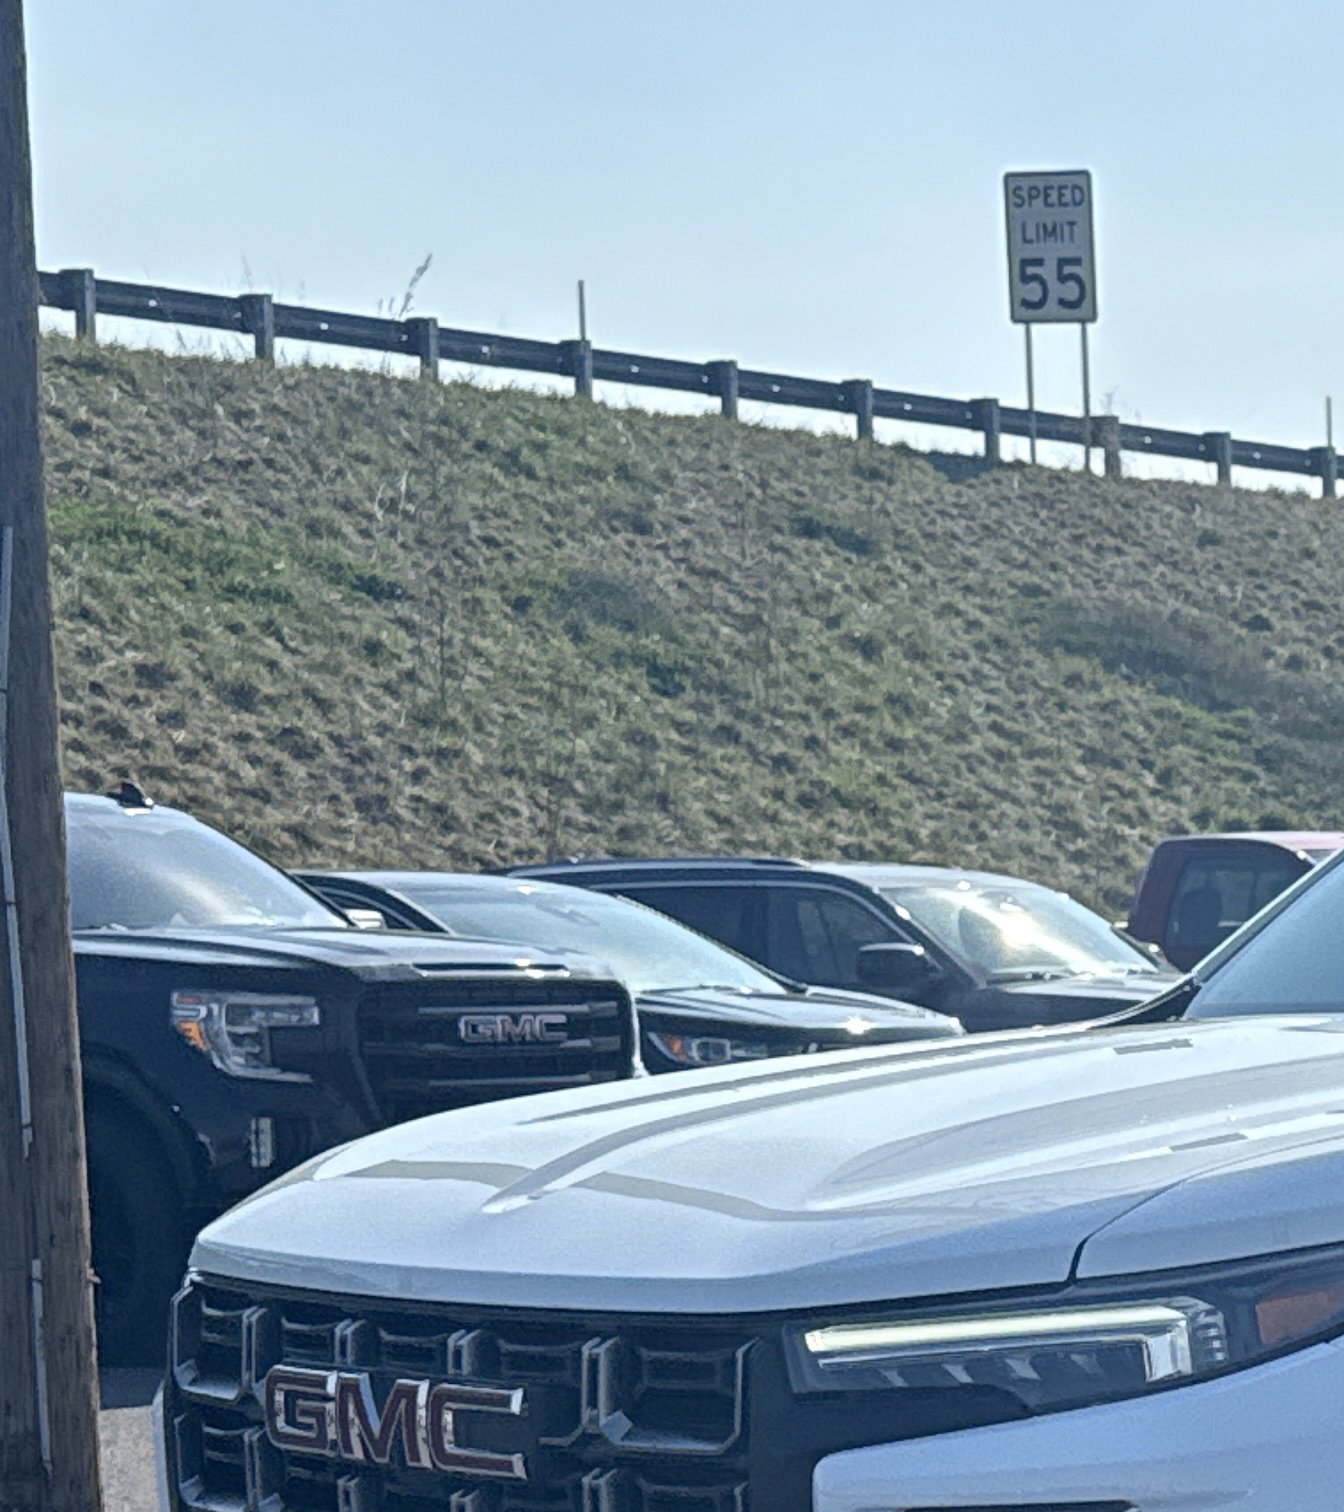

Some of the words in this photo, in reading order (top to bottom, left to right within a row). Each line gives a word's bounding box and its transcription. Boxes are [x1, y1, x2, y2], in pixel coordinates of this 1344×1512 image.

[1011, 184, 1086, 209] SPEED
[1020, 221, 1078, 244] LIMIT
[1018, 256, 1087, 311] 55
[458, 1013, 568, 1043] GMC
[264, 1364, 527, 1481] GMC
